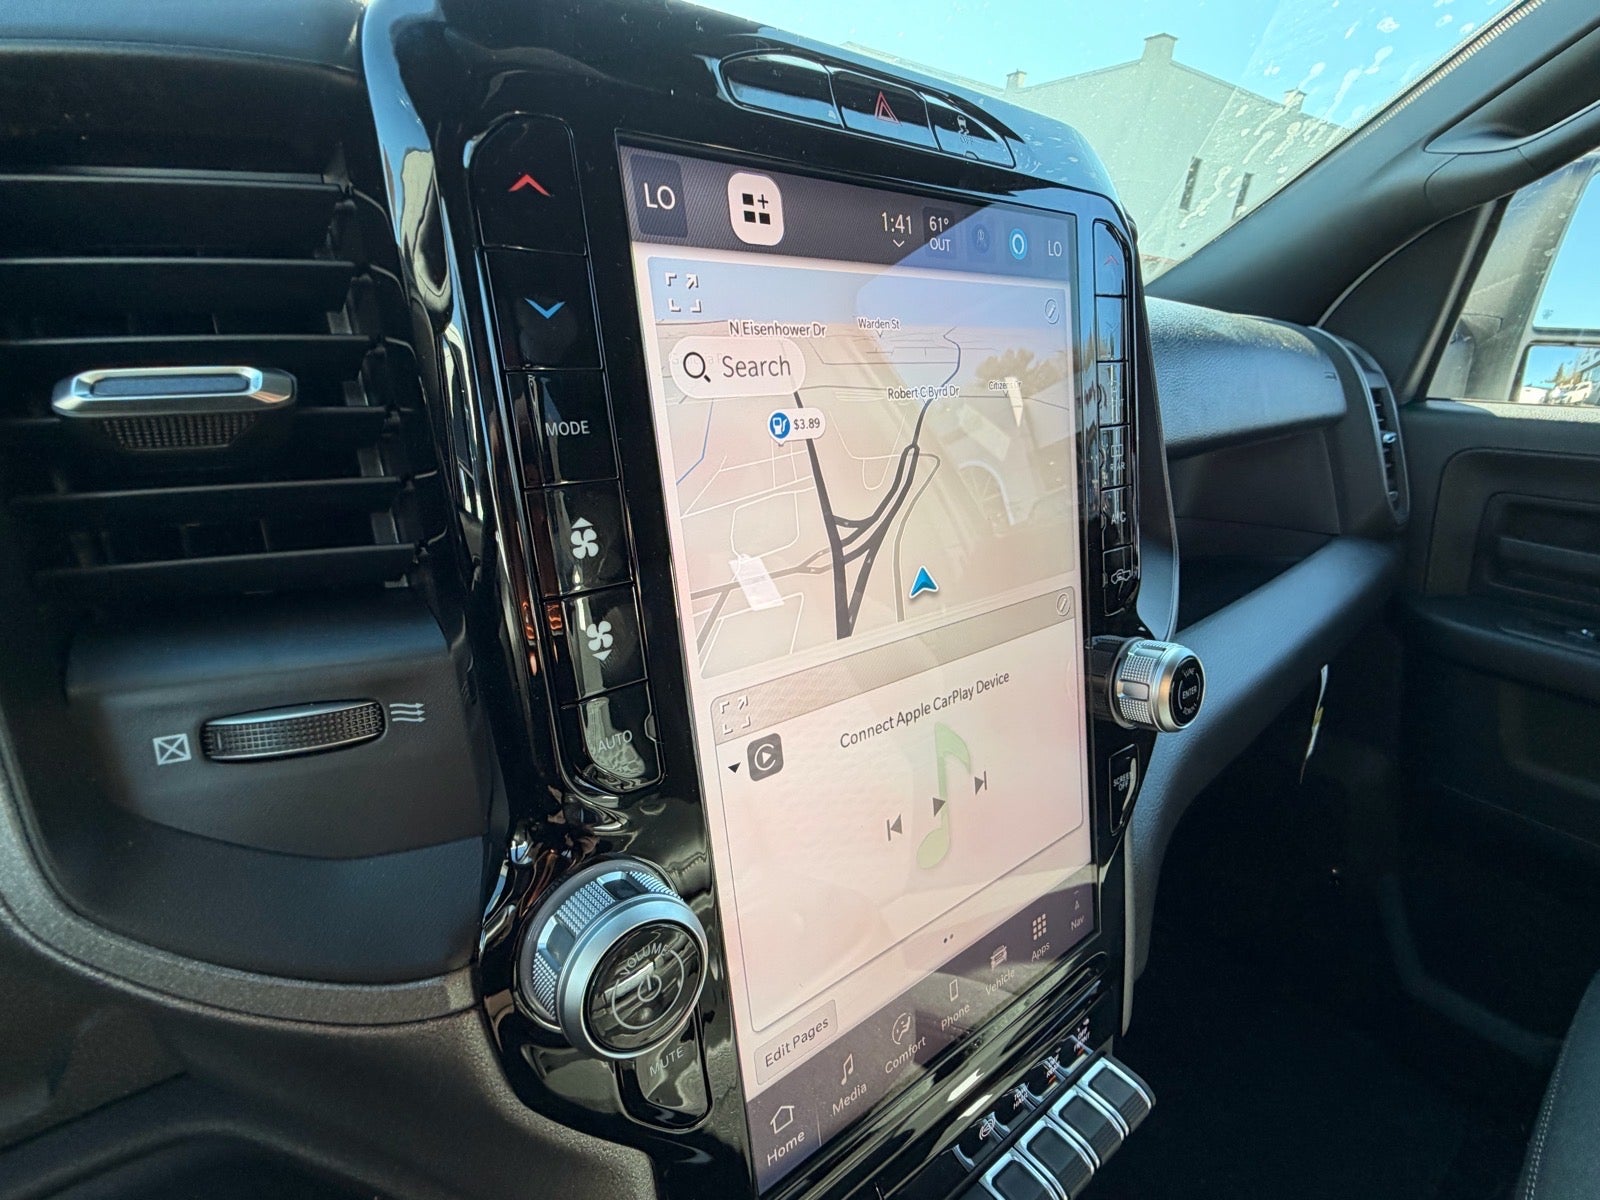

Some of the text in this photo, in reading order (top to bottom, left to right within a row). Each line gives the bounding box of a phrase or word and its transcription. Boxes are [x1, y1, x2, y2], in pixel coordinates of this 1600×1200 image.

[643, 182, 676, 211] LO
[881, 211, 912, 234] 1:41
[929, 215, 949, 232] 61°
[929, 237, 951, 252] OUT
[1047, 239, 1062, 257] LO
[729, 321, 826, 337] N Eisenhower Dr
[858, 318, 900, 330] Warden St
[722, 355, 791, 378] Search
[888, 385, 959, 399] Robert C Byrd Dr
[545, 420, 590, 437] MODE
[793, 417, 820, 430] $3.89
[1110, 461, 1126, 471] RAR
[840, 672, 1010, 748] Connect Apple CarPlay Device
[598, 730, 633, 753] AUTO
[1070, 914, 1085, 932] Nav
[620, 942, 671, 977] VOLUME
[1031, 942, 1051, 962] Apps
[985, 968, 1016, 997] Vehicle
[941, 1003, 971, 1031] Phone
[765, 1017, 829, 1068] Edit Pages
[649, 1046, 685, 1078] MUTE
[885, 1036, 927, 1075] Comfort
[832, 1082, 868, 1116] Media
[766, 1130, 806, 1168] Home
